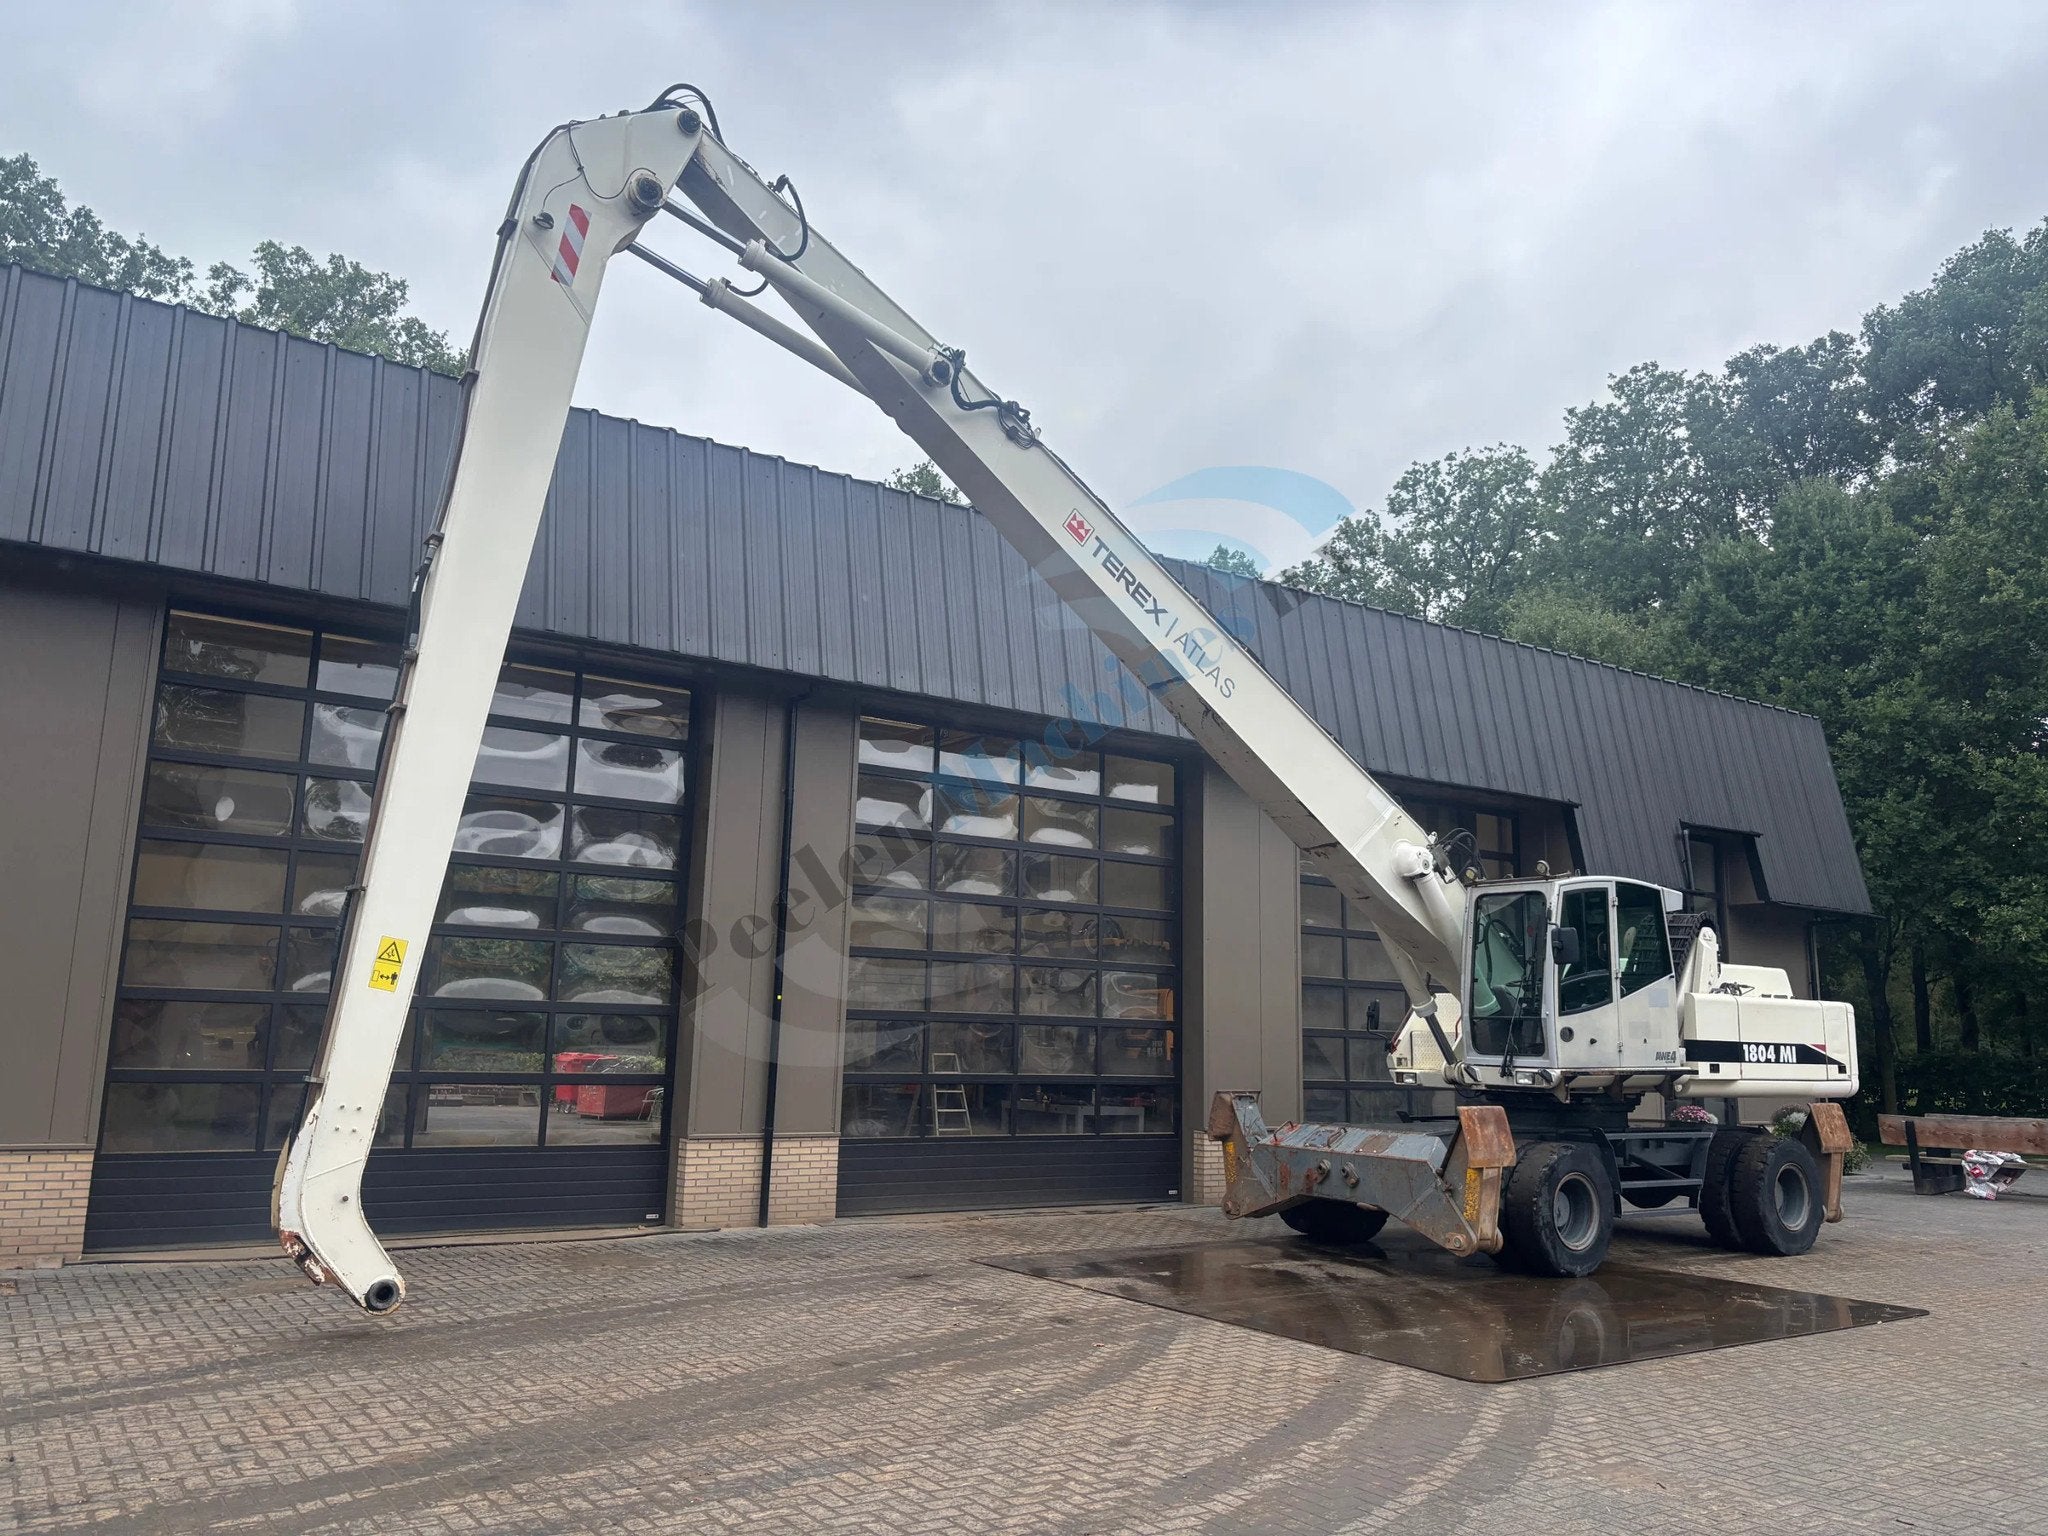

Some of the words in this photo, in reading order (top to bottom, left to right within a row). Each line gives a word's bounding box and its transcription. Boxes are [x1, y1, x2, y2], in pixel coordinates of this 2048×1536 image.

[1092, 535, 1169, 627] TEREX
[1172, 632, 1236, 699] ATLAS
[1742, 1043, 1776, 1063] 1804
[1779, 1045, 1797, 1064] MI
